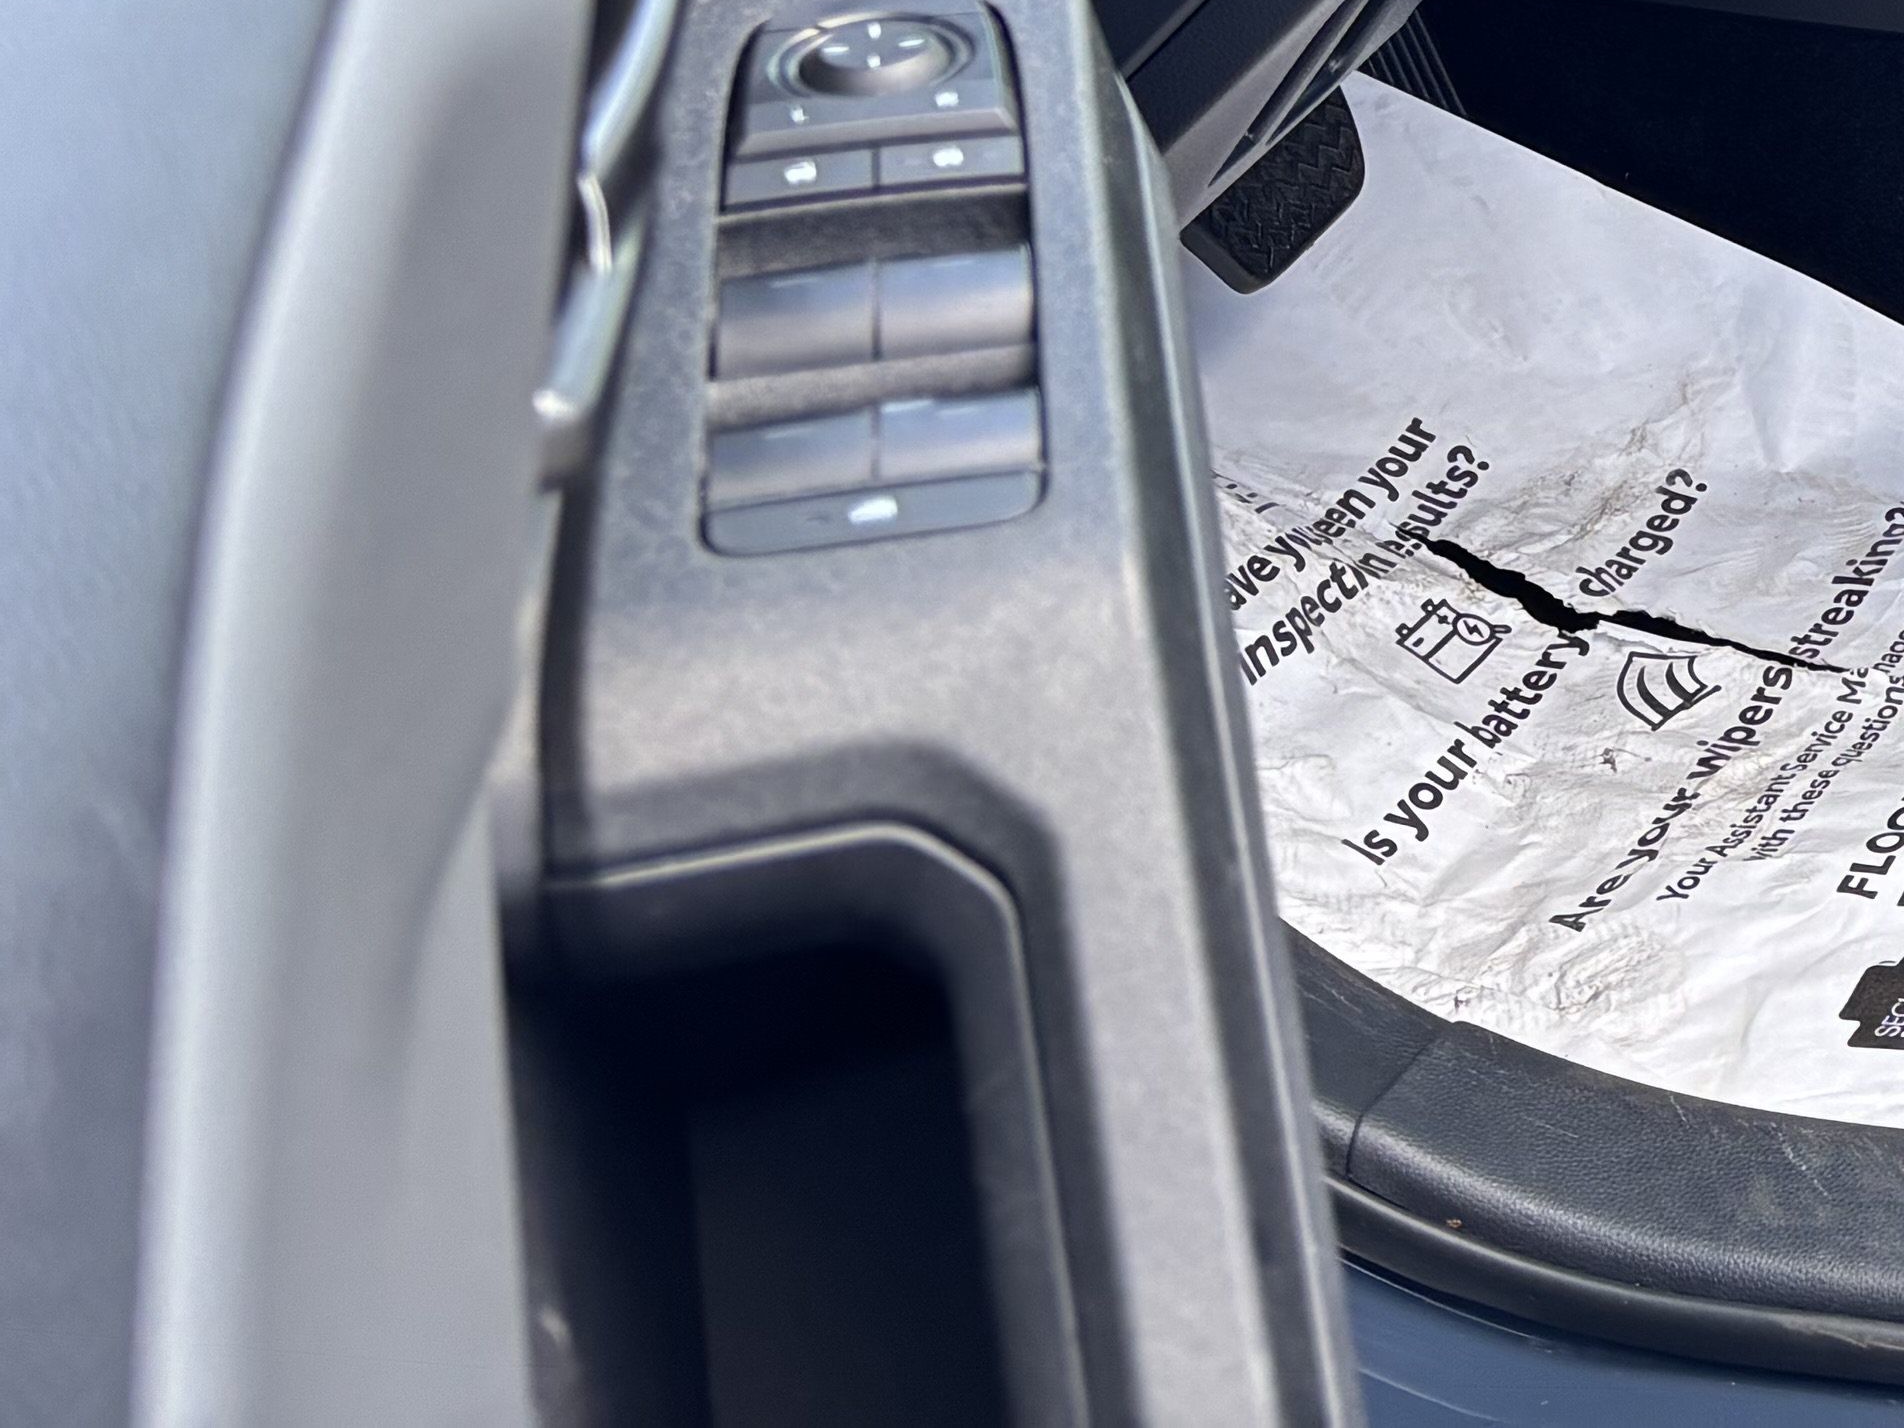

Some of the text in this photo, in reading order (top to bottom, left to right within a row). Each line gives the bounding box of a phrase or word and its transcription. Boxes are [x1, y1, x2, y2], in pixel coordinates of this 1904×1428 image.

[1358, 417, 1436, 501] your
[1341, 468, 1708, 865] Is your battery charged?
[1548, 872, 1629, 932] Are
[1615, 787, 1701, 880] your
[1687, 667, 1794, 781] wipers
[1656, 855, 1718, 902] Your
[1716, 763, 1797, 858] Assistant
[1791, 710, 1853, 772] Service
[1781, 768, 1839, 822] these
